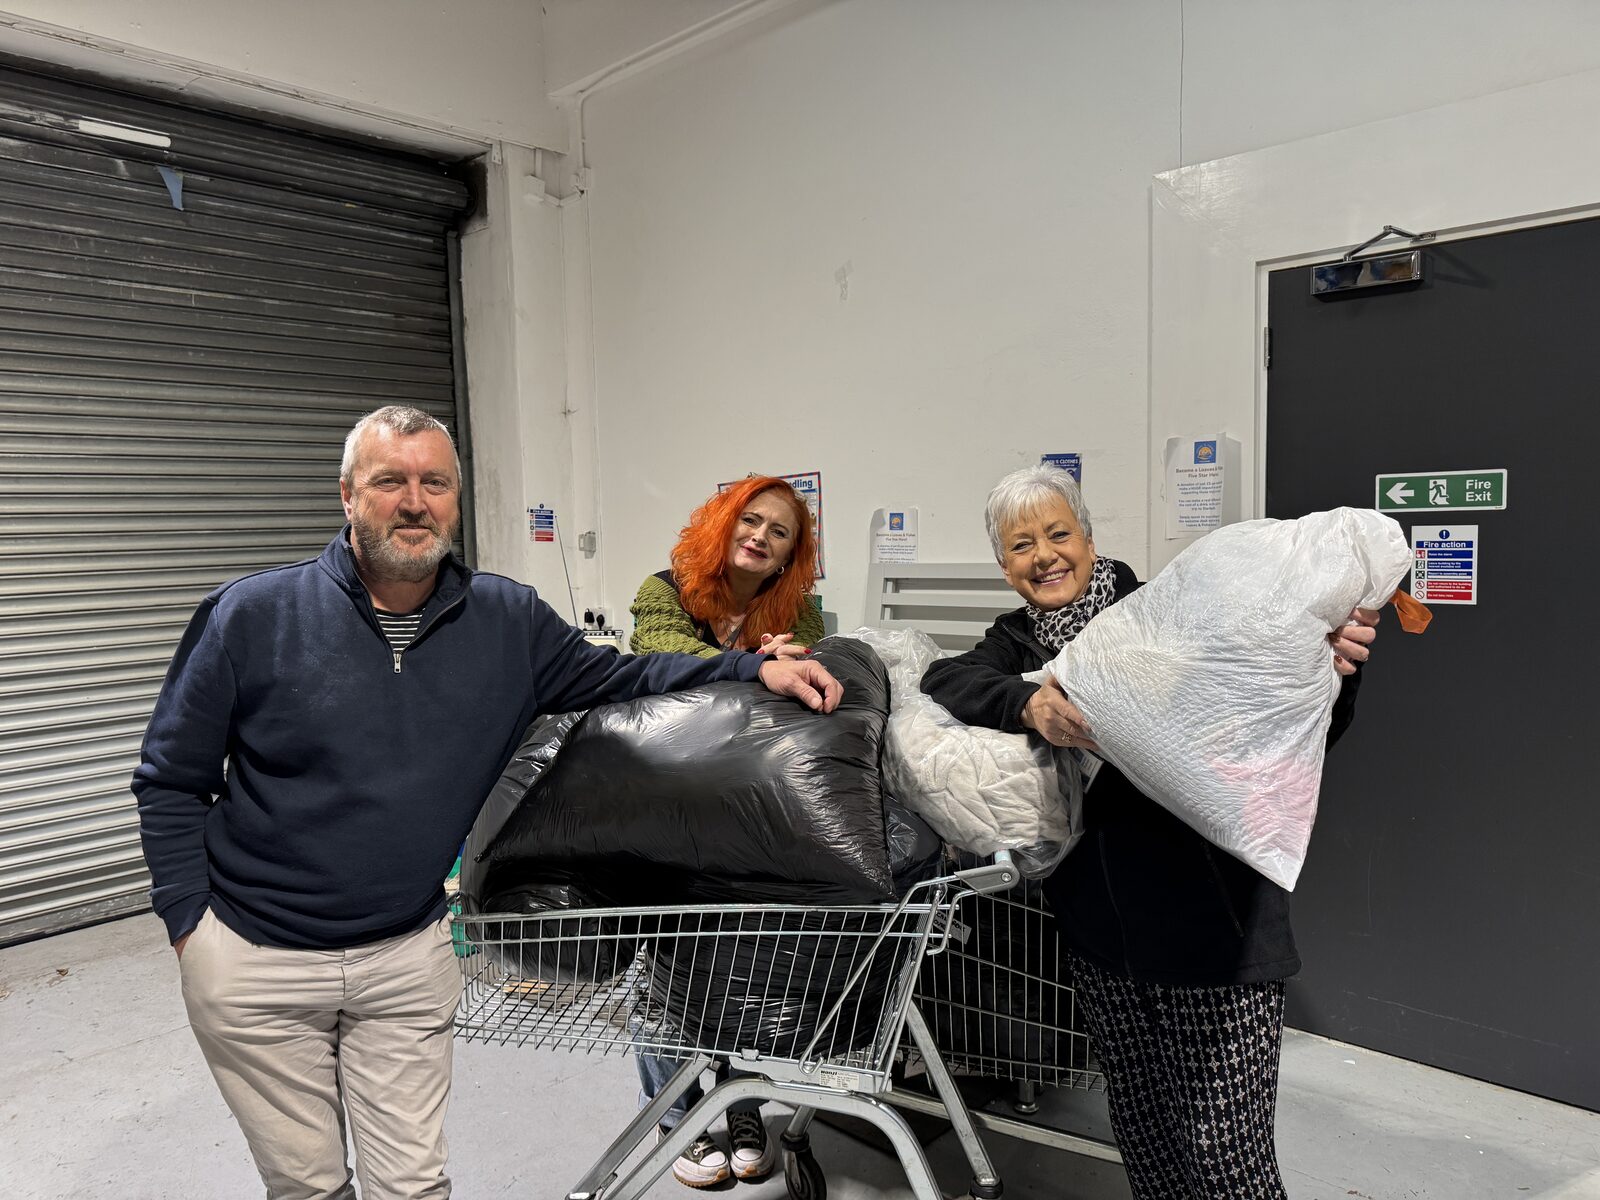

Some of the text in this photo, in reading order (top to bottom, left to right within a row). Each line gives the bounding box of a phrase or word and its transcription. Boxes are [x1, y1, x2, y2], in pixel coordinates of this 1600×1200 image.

[790, 479, 813, 488] dling
[1466, 479, 1491, 489] Fire
[1466, 491, 1492, 501] Exit
